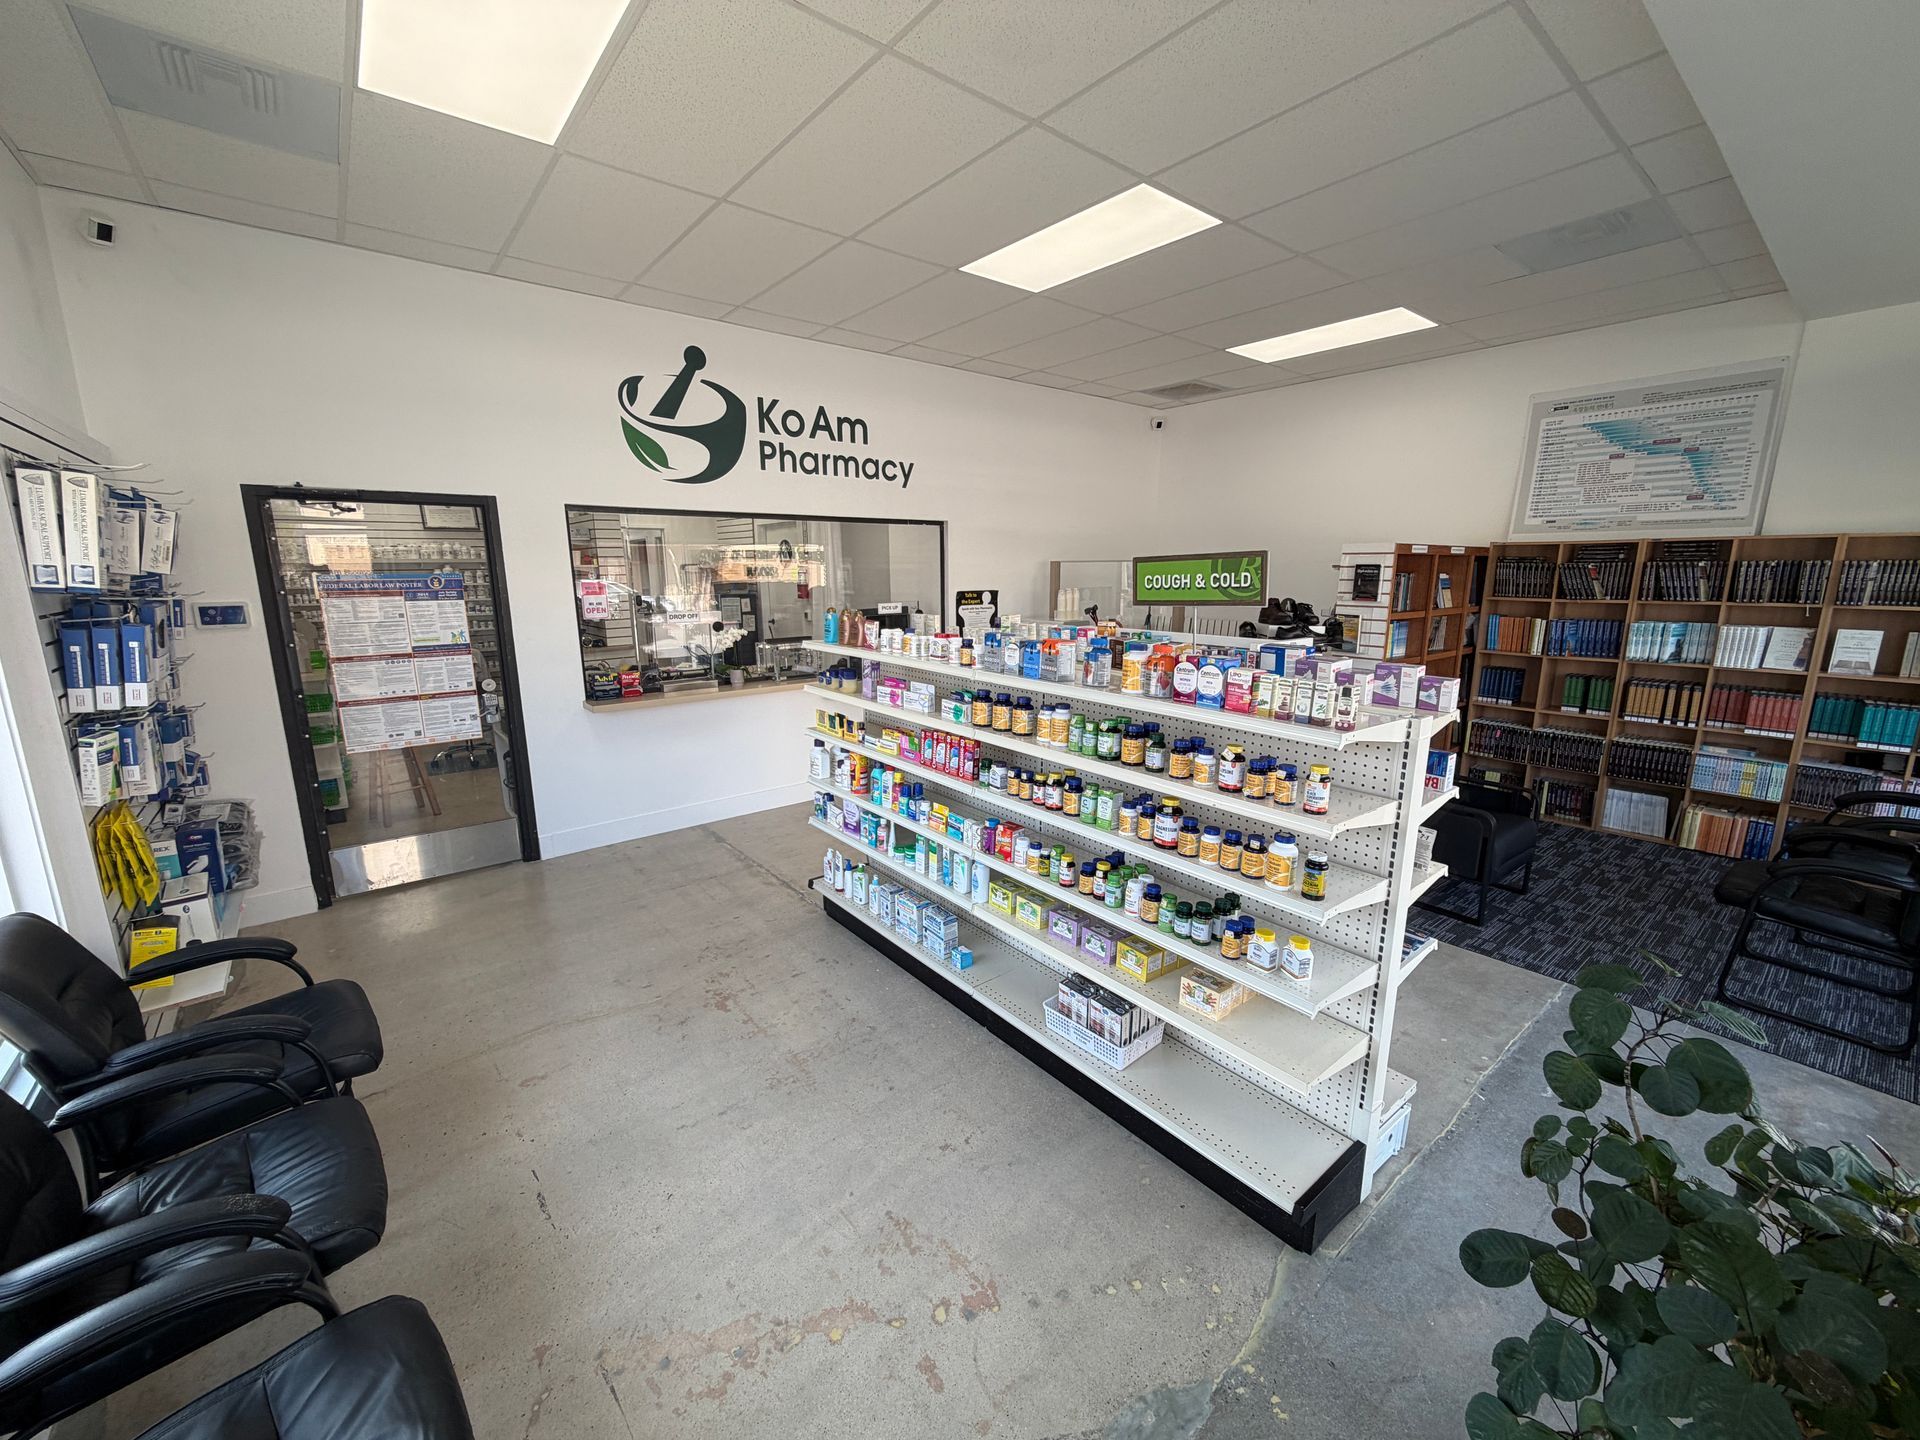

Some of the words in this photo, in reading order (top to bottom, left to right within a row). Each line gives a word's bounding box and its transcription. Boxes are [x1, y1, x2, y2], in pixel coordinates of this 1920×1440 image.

[757, 397, 868, 445] KoAm
[758, 440, 915, 489] Pharmacy
[35, 487, 45, 512] LUMBAR
[79, 489, 87, 514] LUMBAR
[39, 511, 48, 534] SACRAL
[80, 514, 88, 535] SACRAL
[42, 534, 52, 561] SUPPORT
[81, 535, 90, 561] SUPPORT
[319, 582, 353, 590] FEDERAL
[1144, 573, 1191, 590] COUGH
[1195, 575, 1206, 589] &
[1210, 571, 1252, 589] COLD
[597, 674, 614, 682] Advil
[1176, 666, 1195, 674] Centrum
[1200, 669, 1220, 678] Centrum
[1155, 824, 1178, 833] MAGNESIUM
